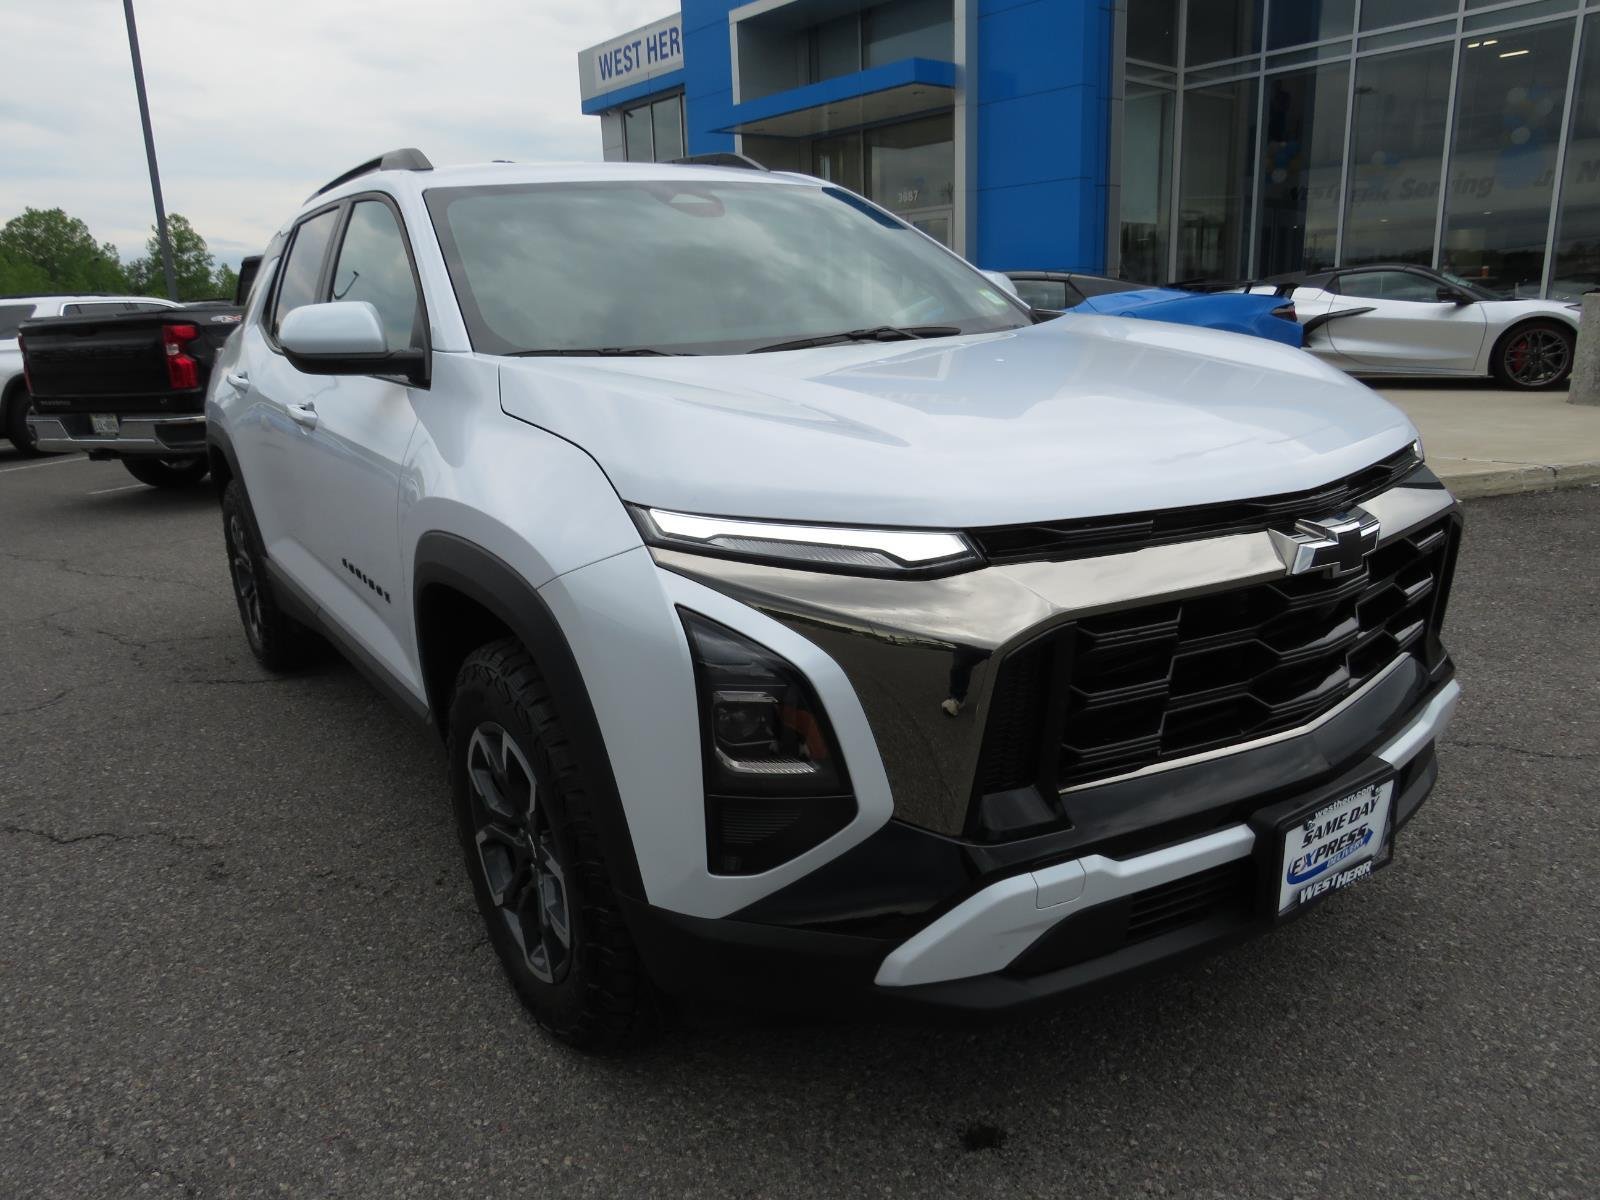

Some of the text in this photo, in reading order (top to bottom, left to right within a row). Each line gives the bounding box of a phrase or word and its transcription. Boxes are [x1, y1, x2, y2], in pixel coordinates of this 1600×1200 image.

[598, 40, 641, 80] WEST
[1400, 172, 1495, 199] Sering
[1302, 796, 1380, 848] SAME DAY
[1293, 823, 1369, 875] EXPRESS
